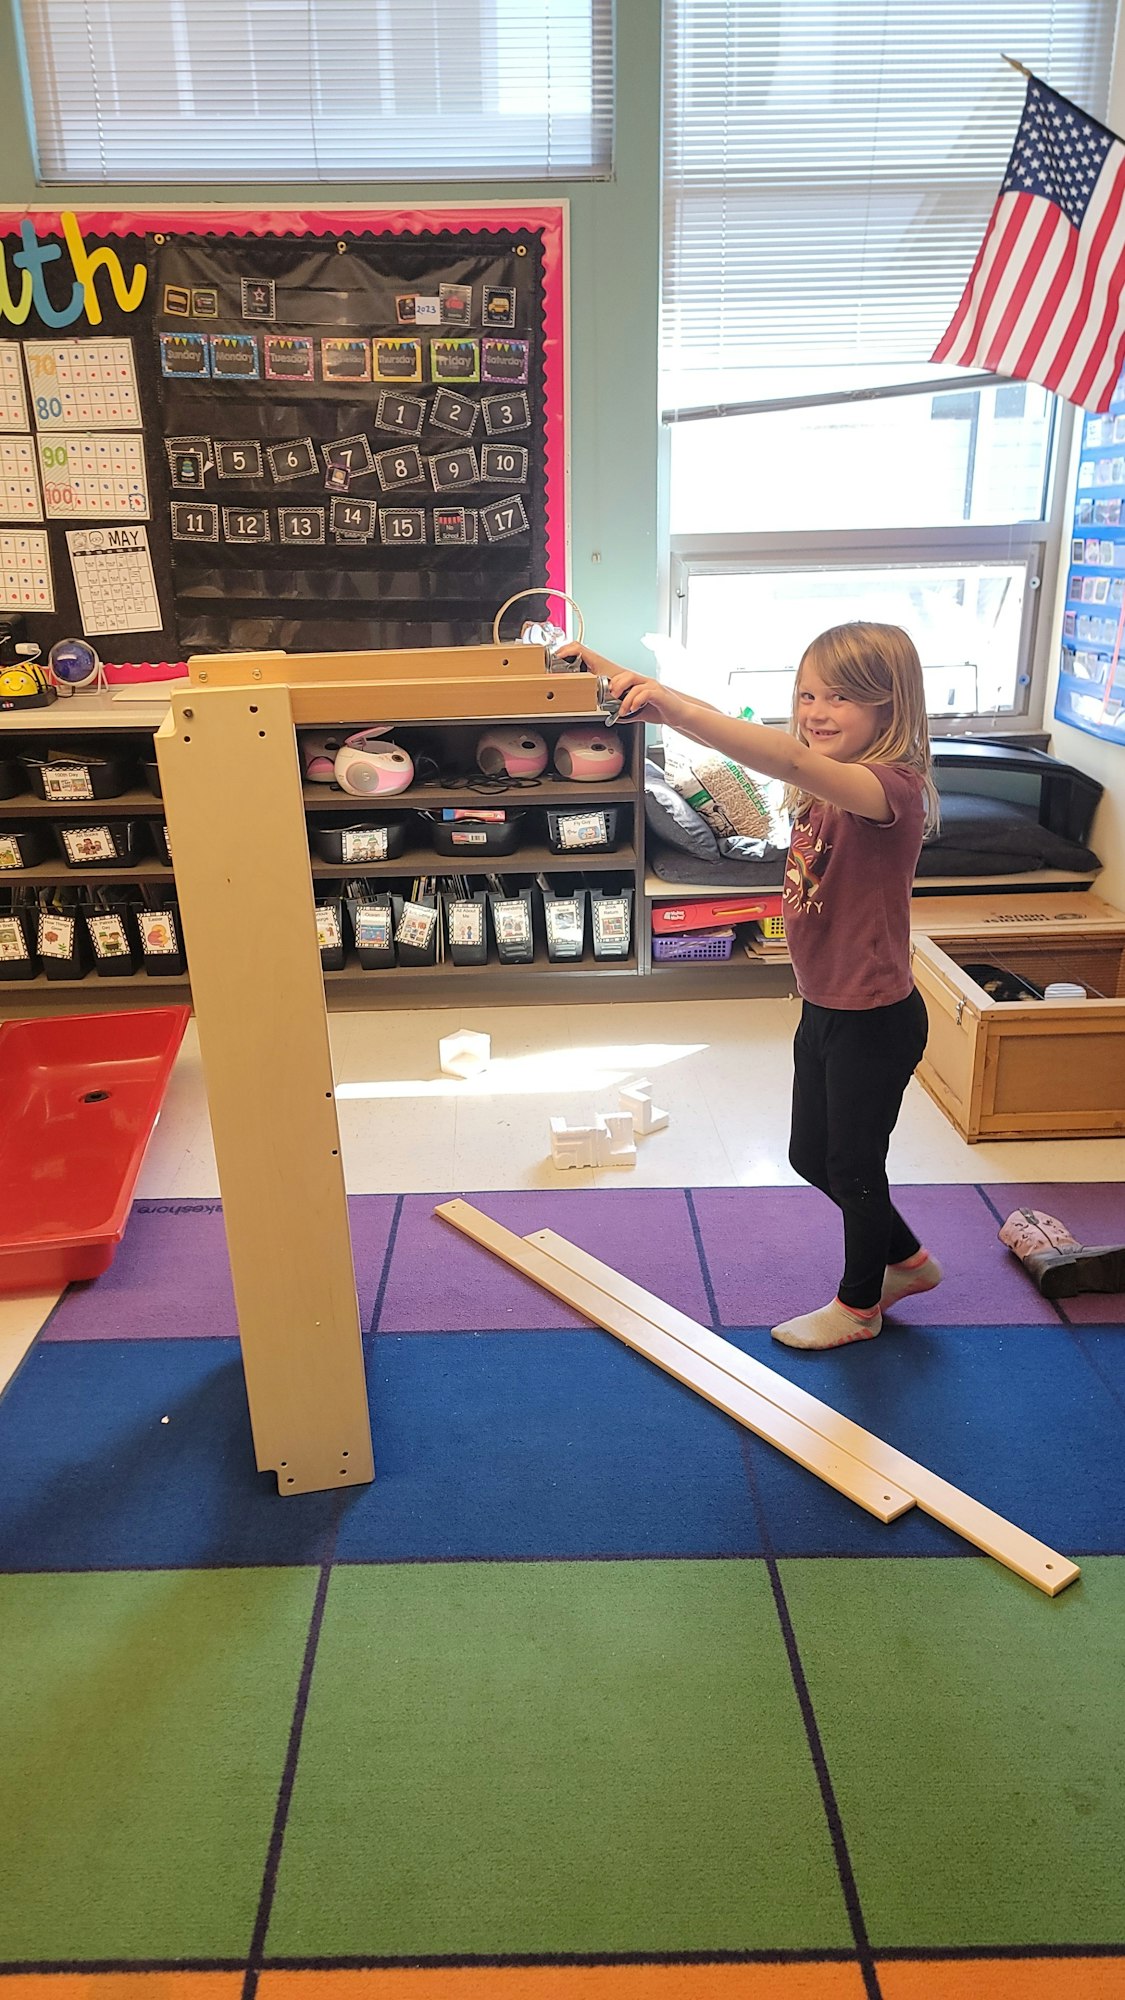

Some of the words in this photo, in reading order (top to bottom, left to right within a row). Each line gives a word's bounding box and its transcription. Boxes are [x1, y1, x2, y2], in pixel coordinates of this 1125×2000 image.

[416, 305, 436, 315] 2023
[167, 350, 200, 362] Sunday
[215, 350, 253, 363] Monday
[270, 352, 309, 366] Tuesday
[378, 354, 416, 366] Thursday
[438, 354, 472, 368] Friday
[486, 355, 525, 368] Saturday
[28, 354, 56, 378] 70
[36, 396, 62, 420] 80
[395, 405, 405, 424] 1
[450, 404, 462, 421] 2
[500, 405, 513, 424] 3
[43, 446, 67, 468] 90
[232, 451, 246, 470] 5
[287, 451, 298, 468] 6
[339, 449, 353, 467] 7
[496, 455, 515, 472] 10
[394, 459, 408, 478] 8
[449, 462, 460, 478] 9
[45, 488, 73, 505] 100
[186, 513, 205, 532] 11
[236, 516, 258, 534] 12
[343, 507, 362, 525] 14
[494, 509, 514, 532] 17
[291, 517, 312, 535] 13
[391, 518, 414, 538] 15
[108, 530, 139, 547] MAY
[742, 782, 766, 816] PELLETS
[137, 1204, 223, 1215] akeshore
